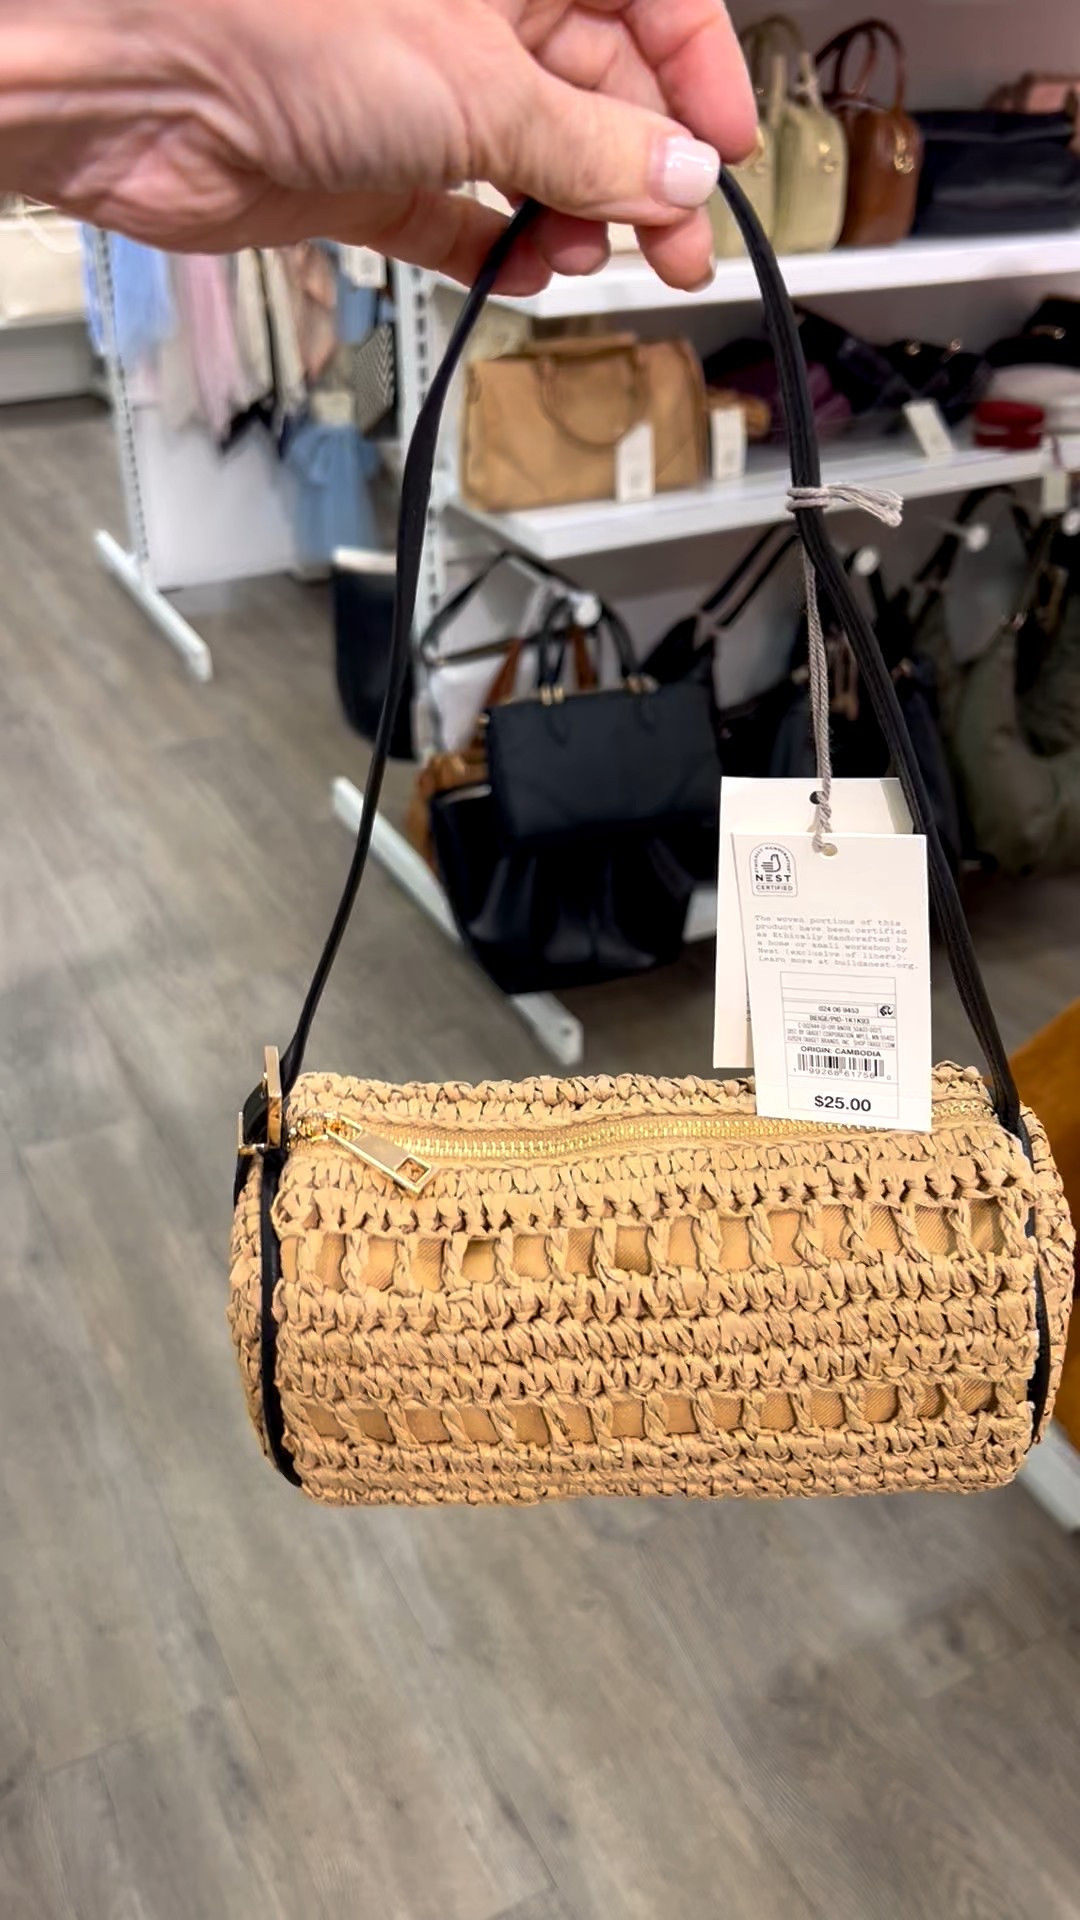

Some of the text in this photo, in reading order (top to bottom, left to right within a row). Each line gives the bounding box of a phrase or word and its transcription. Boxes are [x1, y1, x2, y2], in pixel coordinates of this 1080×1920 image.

[755, 873, 791, 882] NEST
[810, 917, 855, 925] portions
[855, 927, 907, 935] certified
[773, 931, 823, 941] Ethically
[827, 934, 890, 942] Handcrafted
[785, 948, 840, 957] (exclusive
[845, 944, 890, 952] workshop
[896, 945, 908, 953] by
[759, 955, 786, 963] Learn
[834, 959, 919, 970] buildanest.org.
[801, 1045, 881, 1057] ORIGIN: CAMBODIA
[809, 1067, 840, 1076] 99268
[844, 1070, 875, 1079] 61756
[814, 1094, 872, 1112] $25.00
